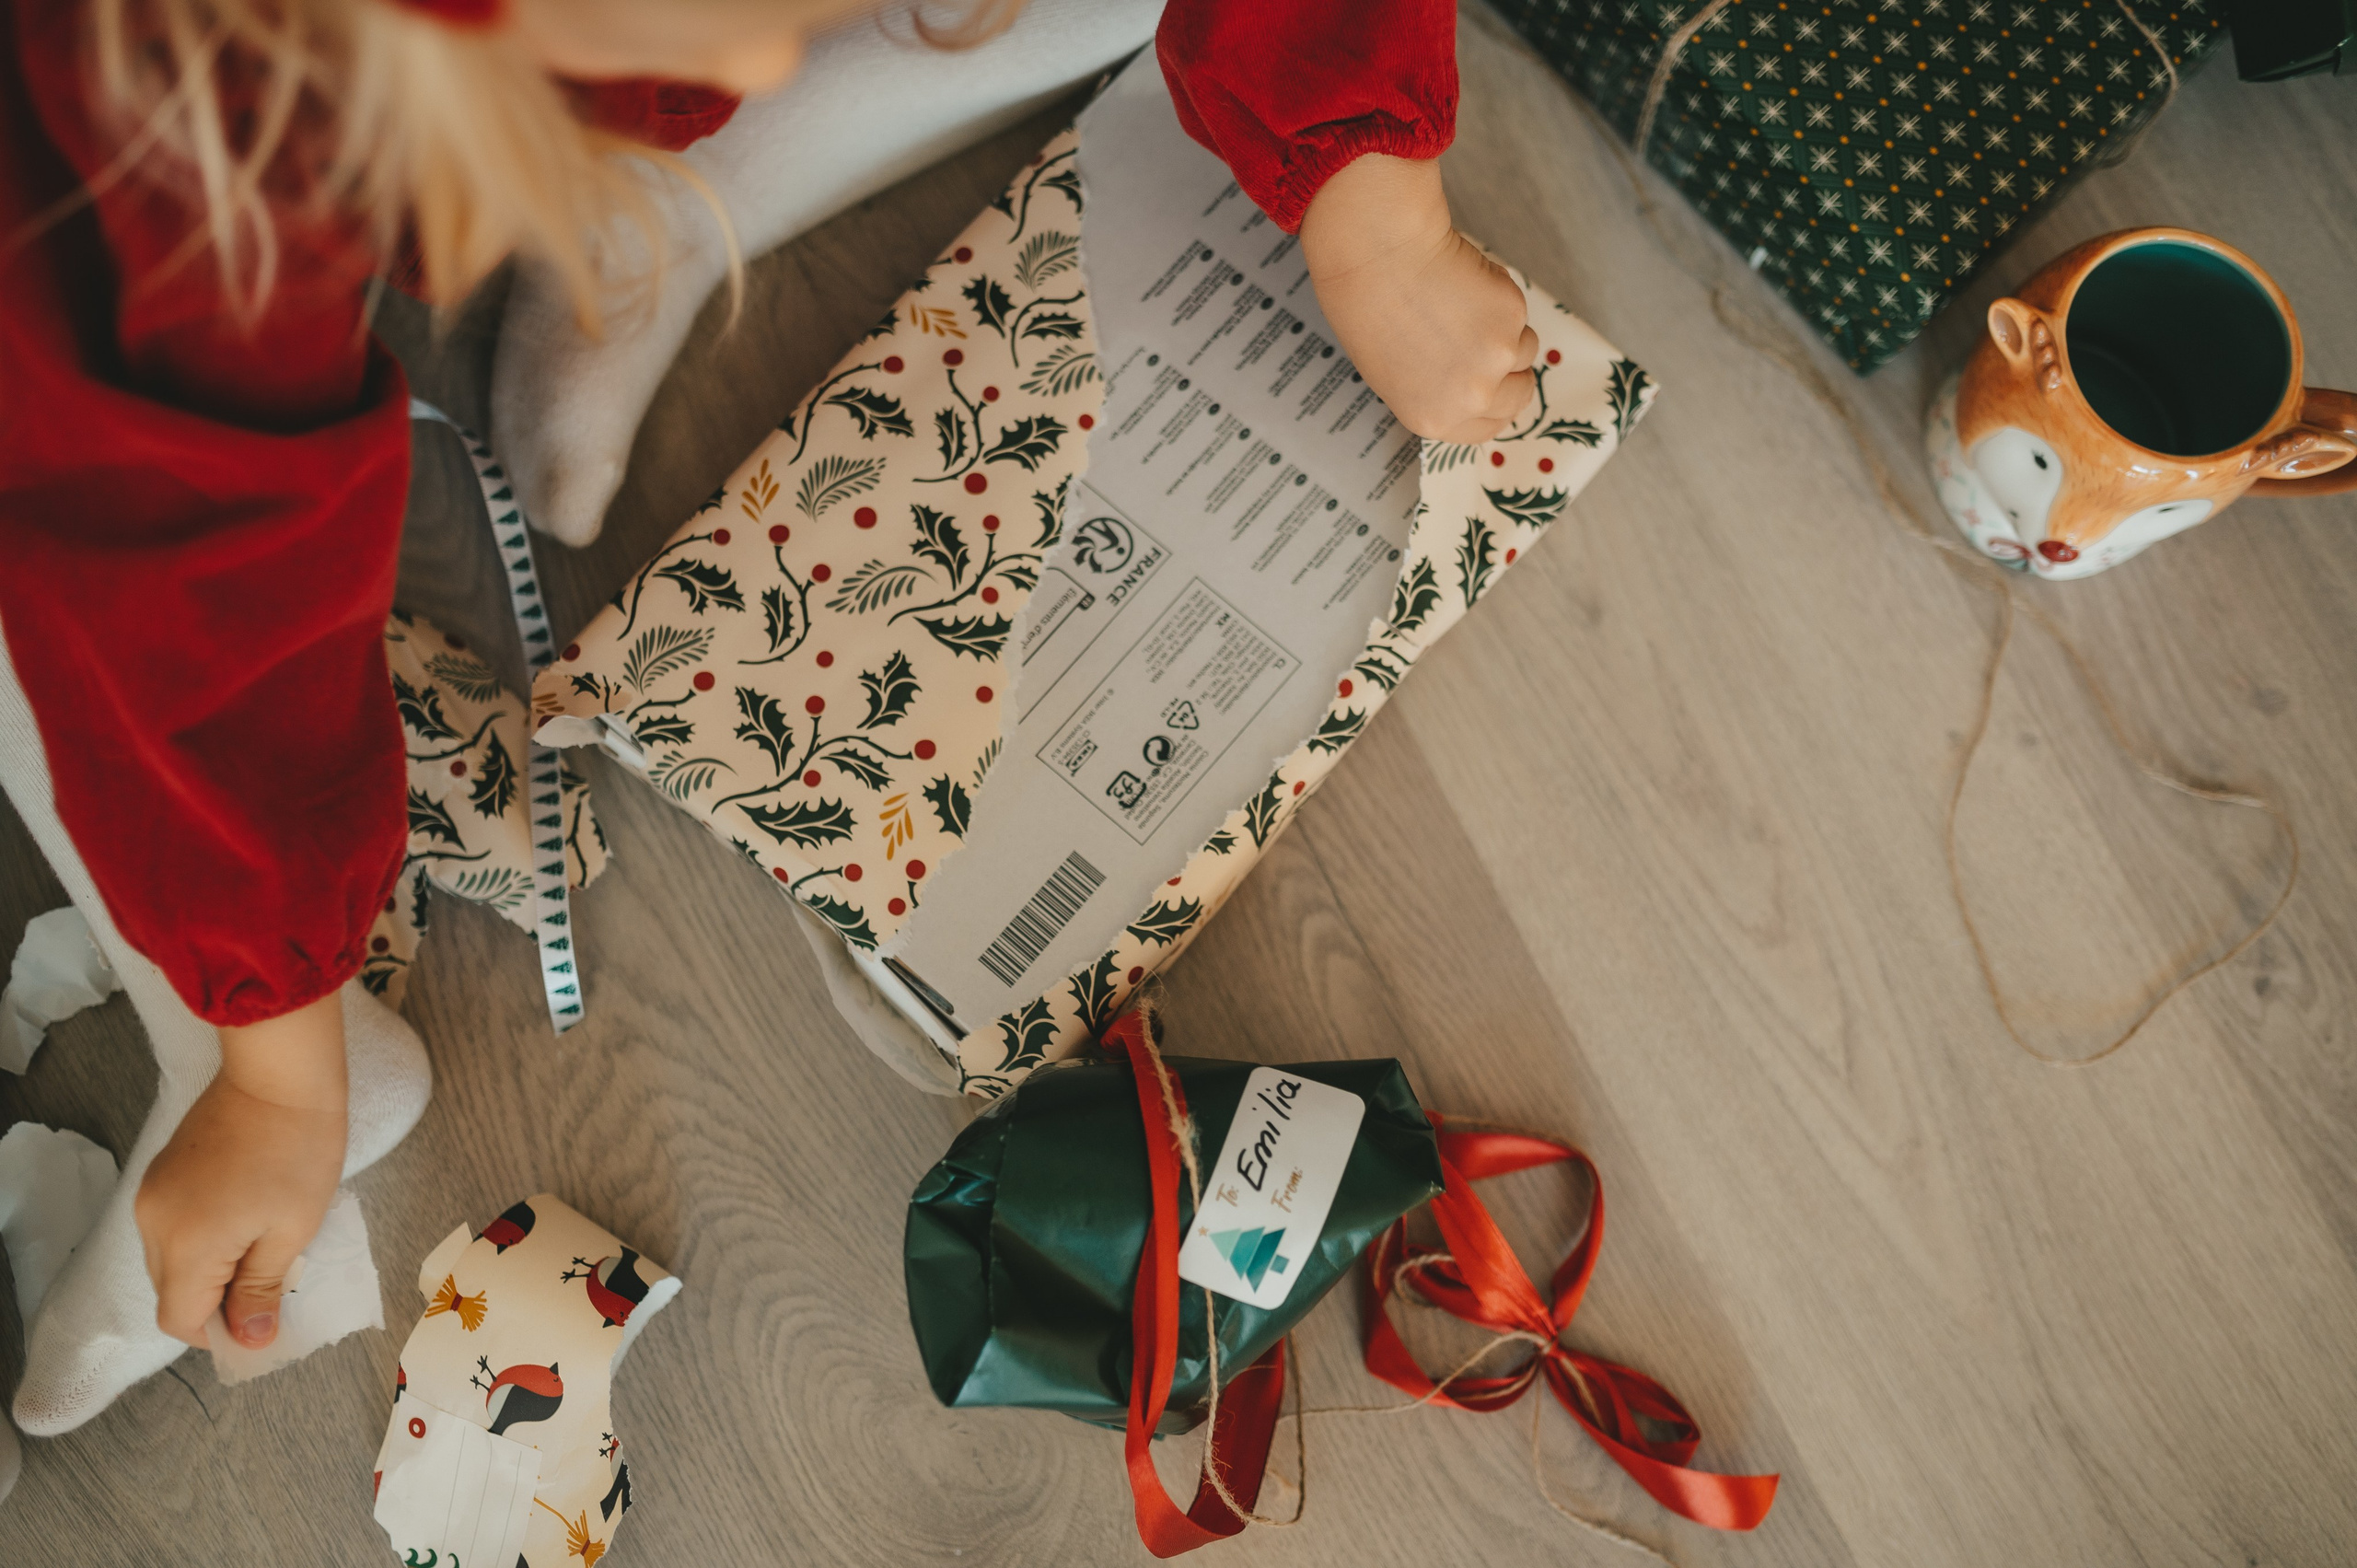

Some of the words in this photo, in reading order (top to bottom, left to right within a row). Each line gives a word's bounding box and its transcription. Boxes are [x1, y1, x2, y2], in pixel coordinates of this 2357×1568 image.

[1106, 545, 1162, 608] FRANCE
[1039, 587, 1078, 629] Éléments
[1214, 610, 1231, 629] MX
[1271, 656, 1287, 672] CL
[1093, 694, 1109, 711] Inter
[1079, 709, 1097, 726] IKEA
[1177, 710, 1190, 724] 04
[1058, 722, 1084, 750] Systems
[1188, 749, 1209, 772] Colonia
[1135, 802, 1161, 831] Segunda
[1237, 1078, 1302, 1191] Emilia
[1215, 1182, 1240, 1208] To:
[1271, 1166, 1304, 1214] From:
